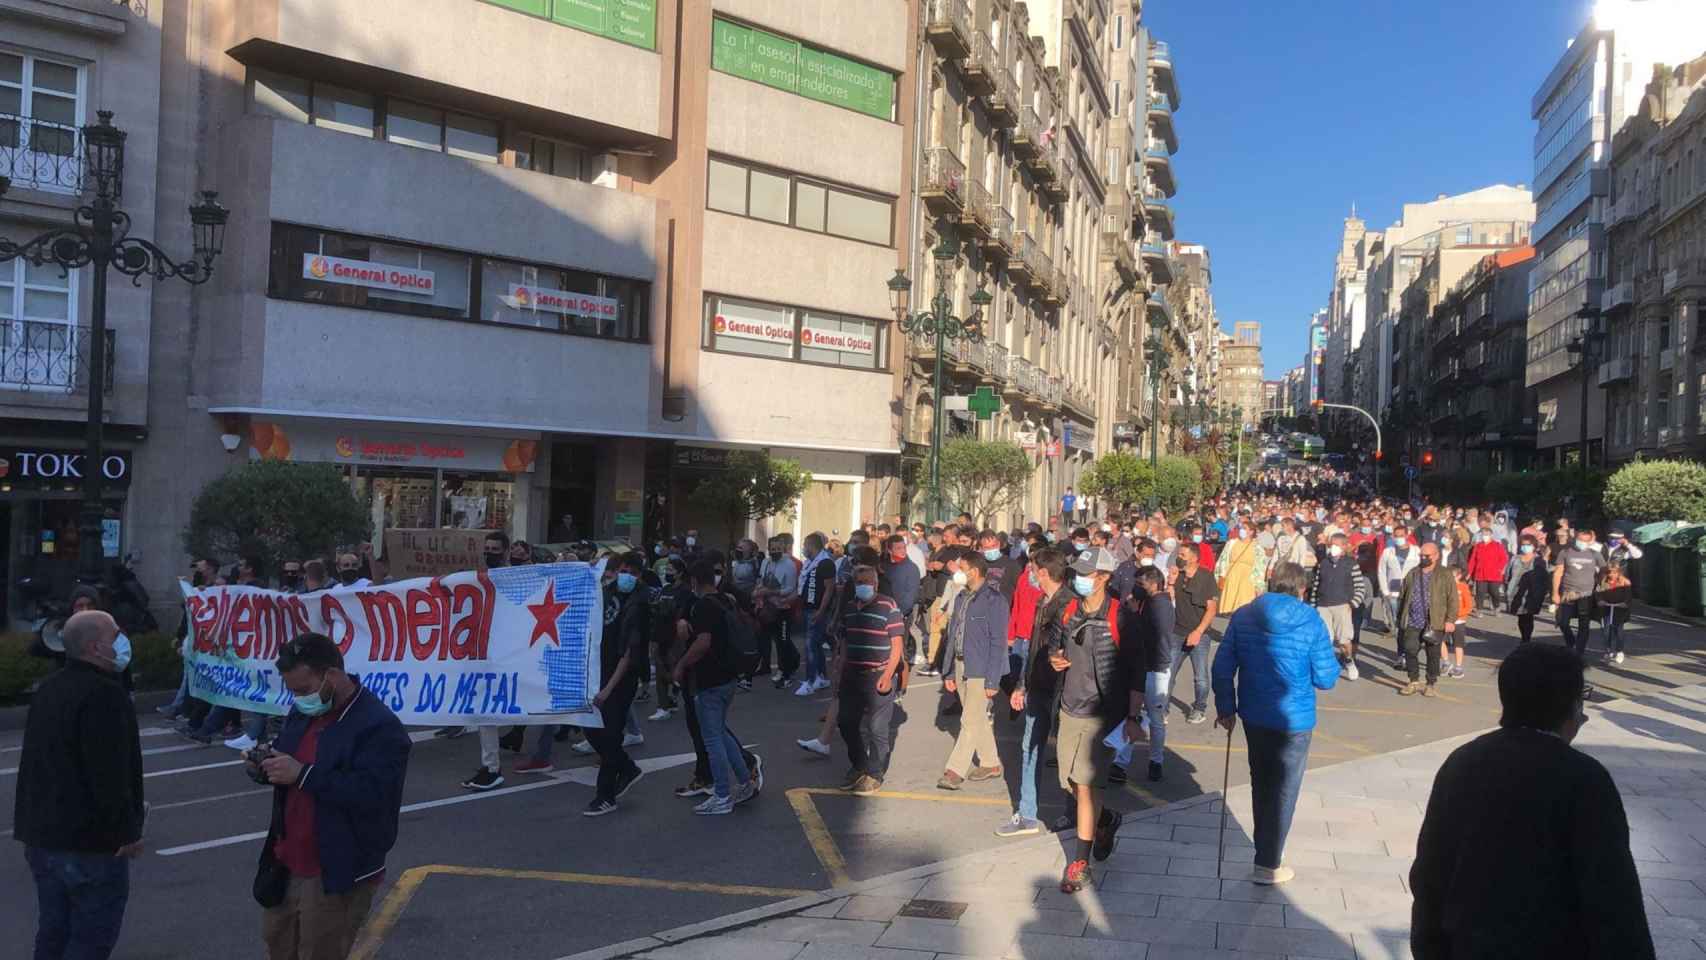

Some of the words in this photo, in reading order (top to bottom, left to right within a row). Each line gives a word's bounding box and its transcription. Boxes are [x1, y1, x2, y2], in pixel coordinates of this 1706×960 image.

[722, 29, 737, 47] La
[758, 42, 804, 67] asesor
[751, 62, 765, 76] en
[333, 263, 386, 283] General
[390, 271, 433, 289] Optica
[536, 292, 577, 309] General
[728, 320, 764, 337] General
[765, 325, 794, 340] Optica
[814, 332, 845, 346] General
[847, 337, 872, 350] Optica
[16, 452, 125, 479] TOKO
[320, 593, 355, 656] o
[355, 567, 496, 662] metal
[248, 668, 273, 703] DE
[414, 672, 446, 713] DO
[450, 671, 521, 715] METAL
